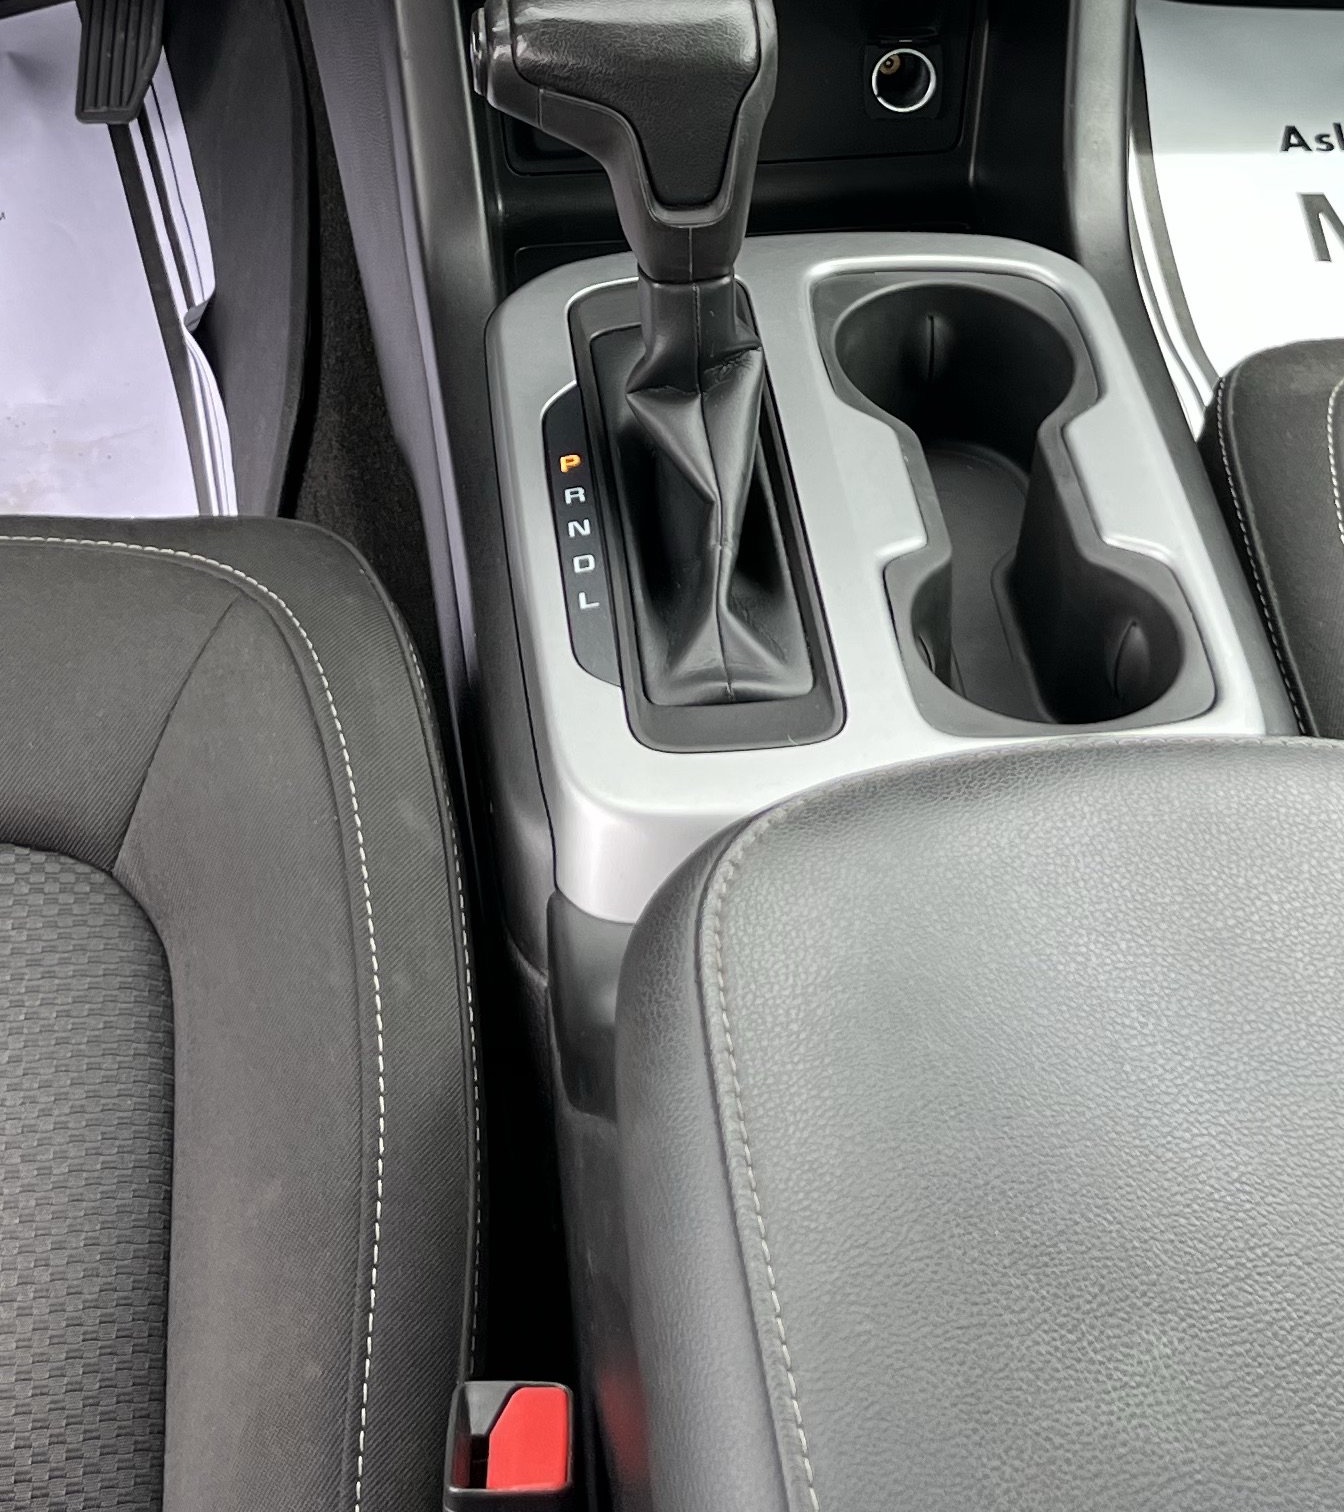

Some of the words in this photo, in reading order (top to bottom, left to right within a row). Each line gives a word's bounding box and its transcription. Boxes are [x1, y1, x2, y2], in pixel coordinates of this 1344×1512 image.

[559, 454, 582, 473] P
[564, 486, 586, 505] R
[567, 518, 591, 538] N
[572, 554, 596, 574] D
[578, 591, 601, 610] L
